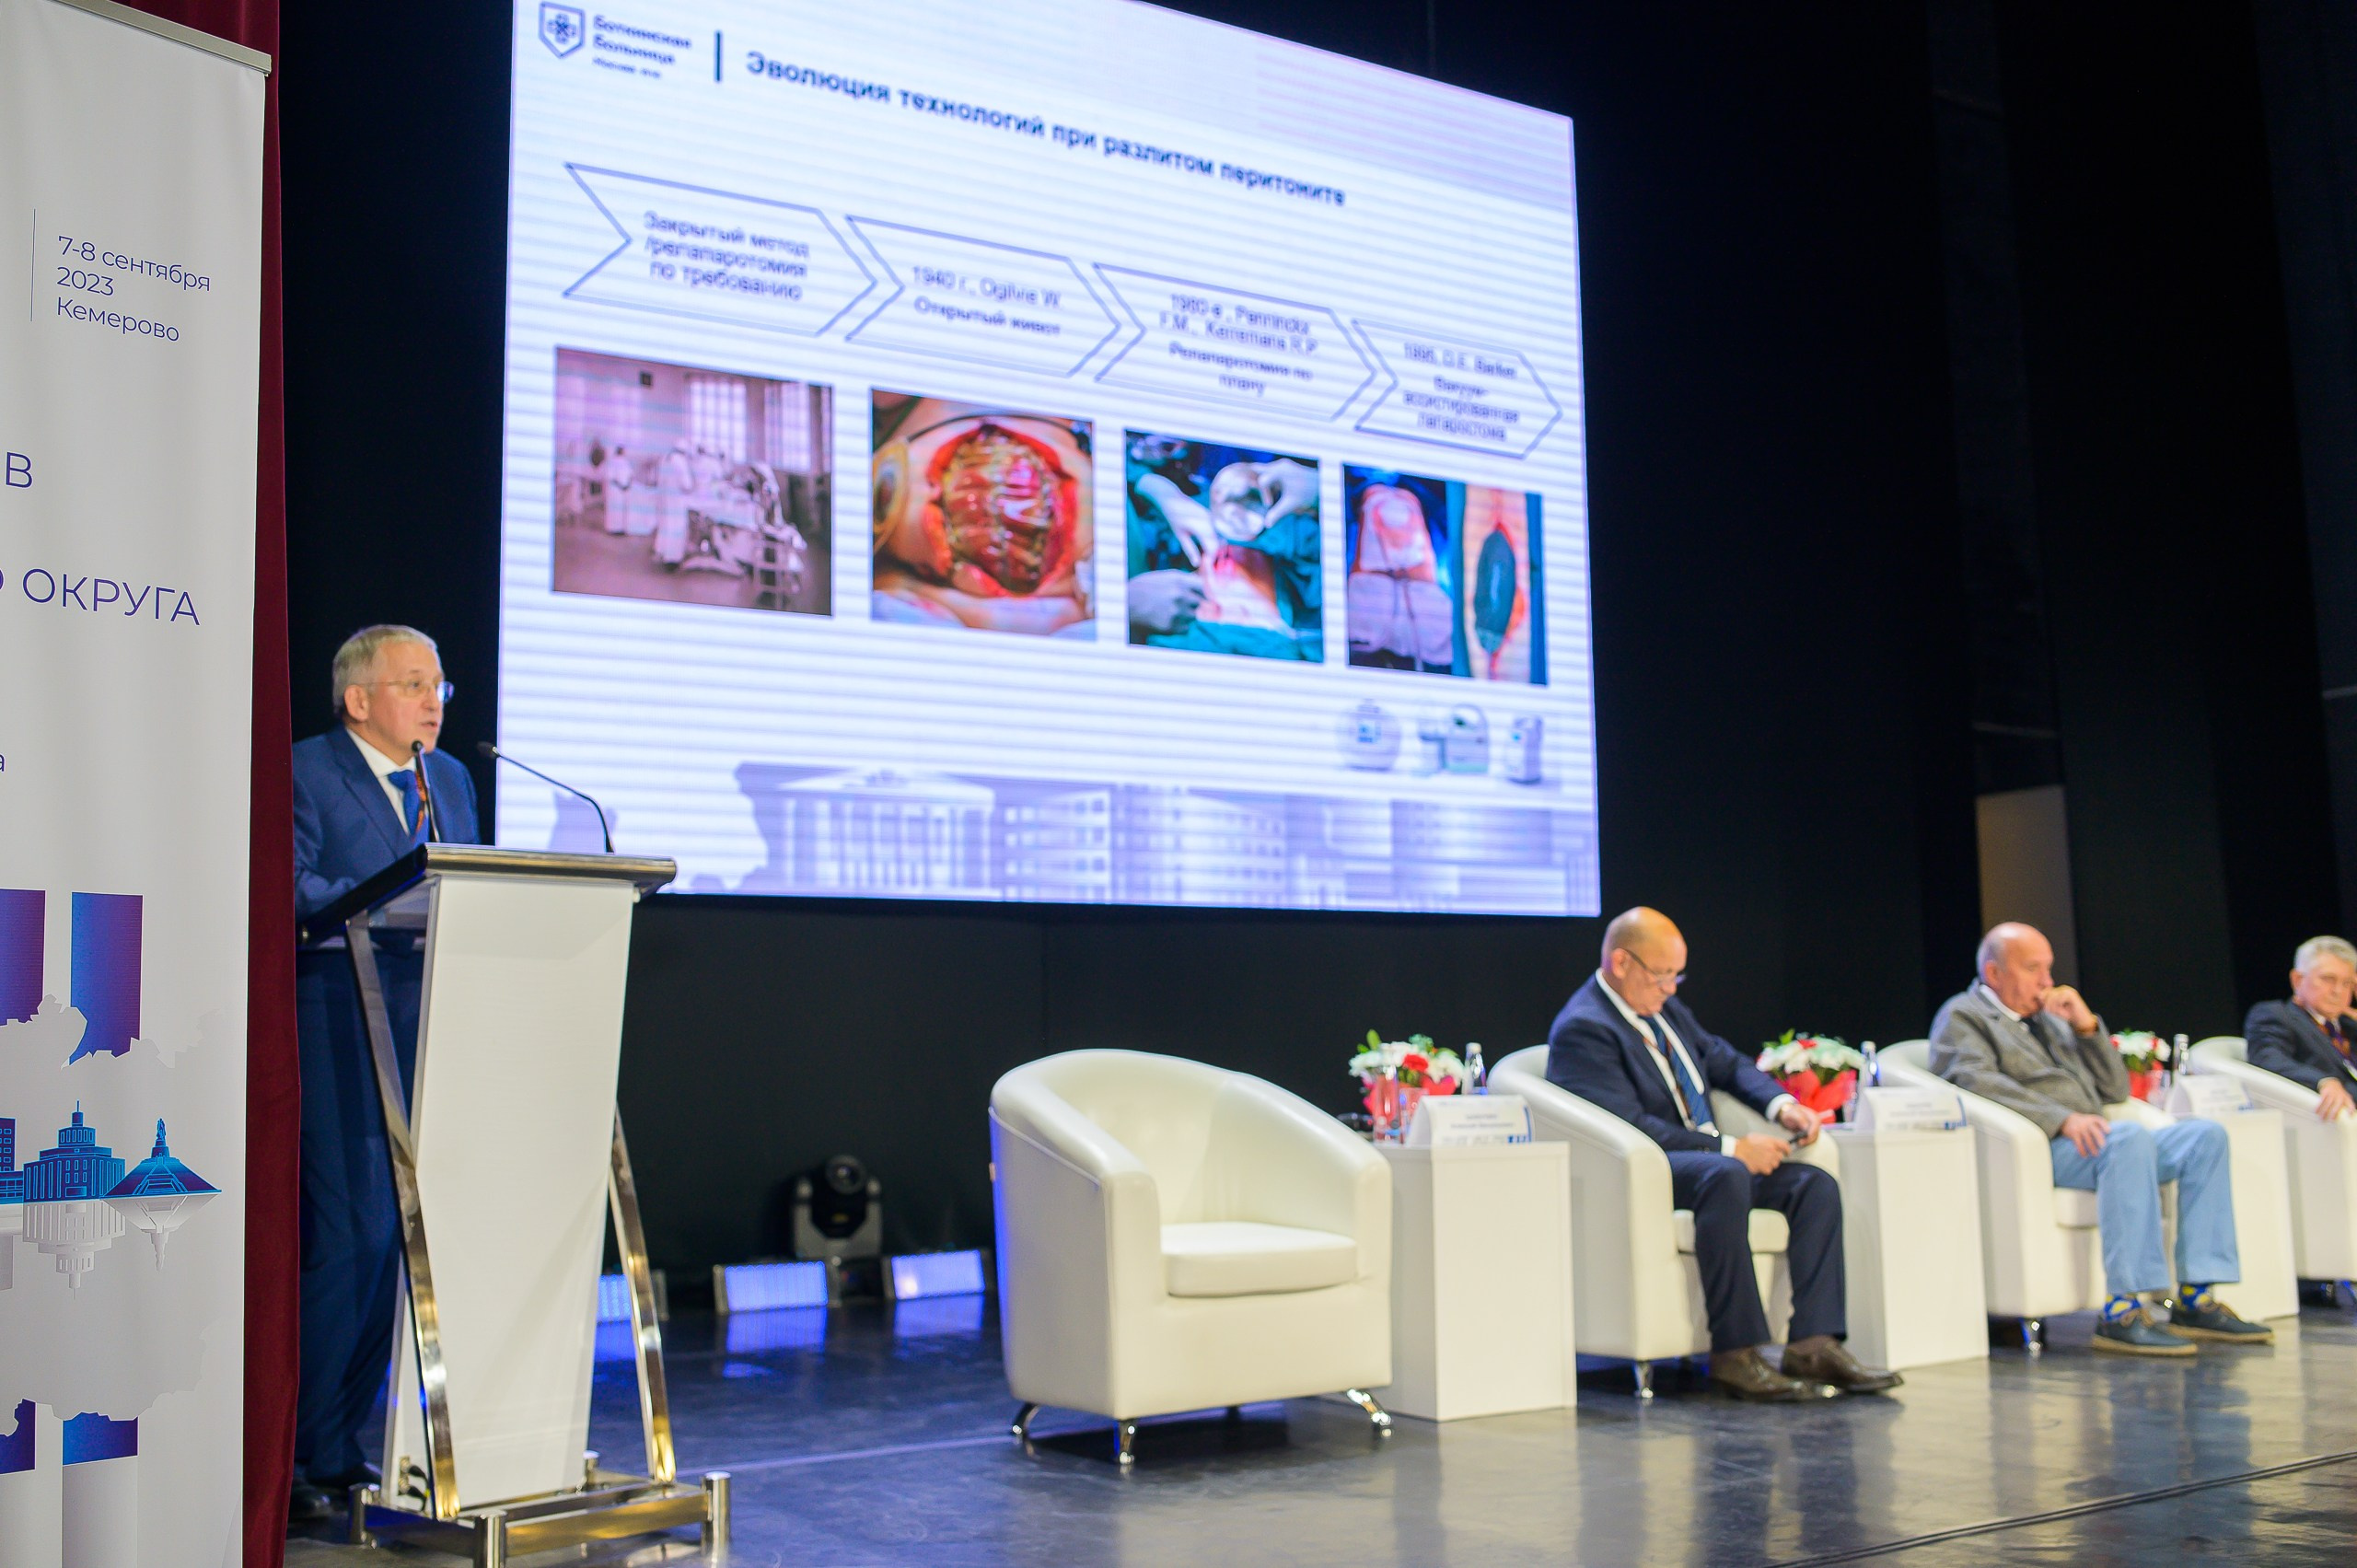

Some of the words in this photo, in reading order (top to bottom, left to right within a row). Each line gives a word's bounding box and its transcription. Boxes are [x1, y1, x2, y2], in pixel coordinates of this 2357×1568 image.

[746, 50, 891, 104] Эволюция
[897, 88, 1046, 139] технологий
[1051, 122, 1097, 150] при
[1103, 135, 1214, 176] разлитом
[1220, 160, 1346, 207] перитоните
[644, 210, 747, 243] Закрытый
[749, 234, 810, 260] метод
[56, 266, 114, 296] 2023
[58, 235, 96, 261] 7-8
[102, 251, 211, 292] сентября
[650, 261, 676, 281] по
[682, 265, 803, 302] требованию
[57, 296, 180, 342] Кемерово
[913, 295, 1007, 326] Открытый
[22, 568, 201, 626] ОКРУГА
